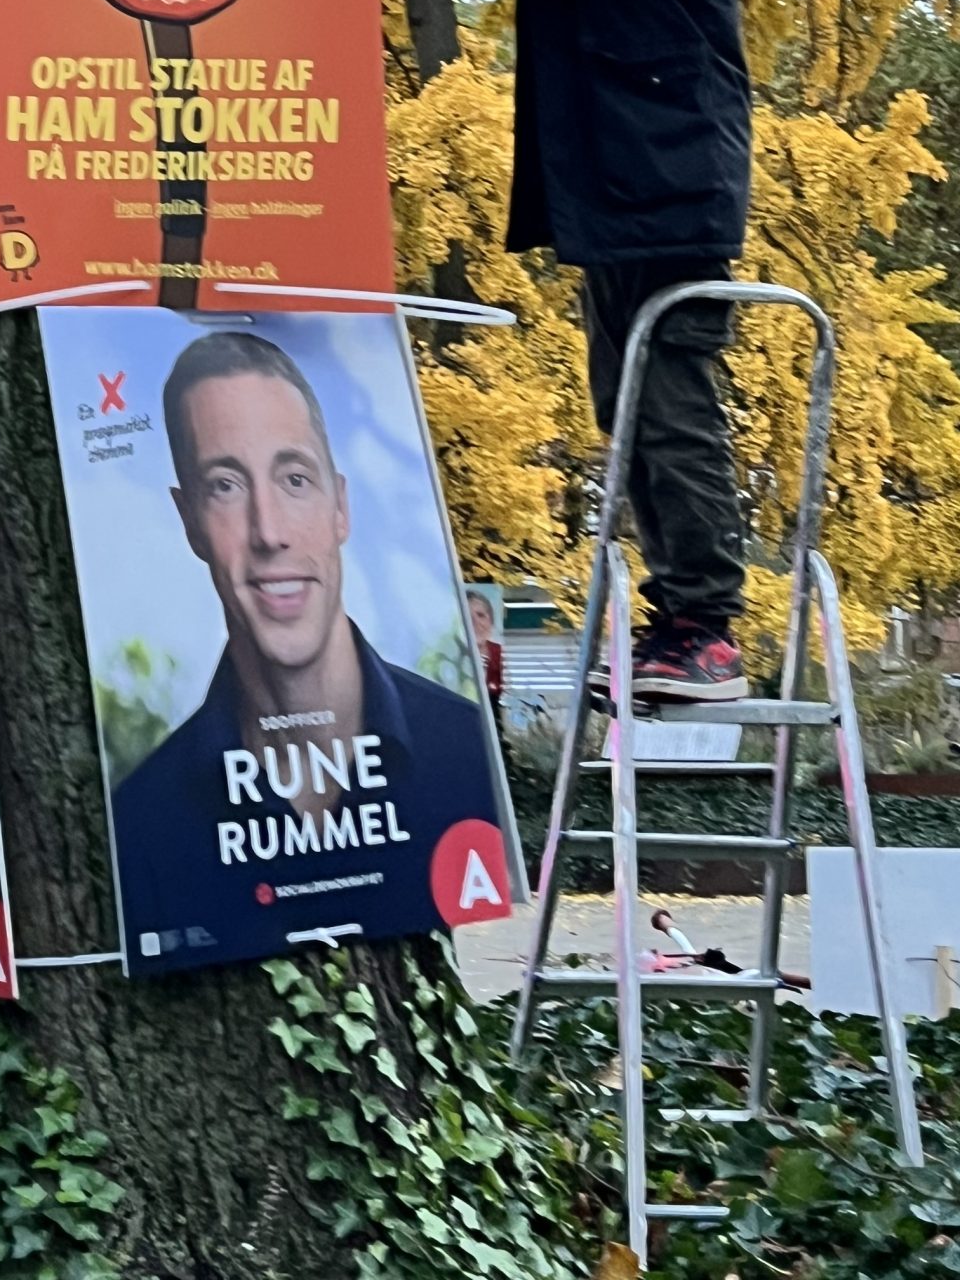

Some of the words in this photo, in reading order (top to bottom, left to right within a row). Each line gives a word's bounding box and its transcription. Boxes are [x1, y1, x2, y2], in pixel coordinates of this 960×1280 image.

[31, 57, 143, 89] OPSTIL
[150, 58, 266, 91] STATUE
[272, 60, 314, 91] AF
[6, 96, 116, 142] HAM
[129, 97, 339, 143] STOKKEN
[27, 143, 68, 180] PÅ
[75, 151, 314, 181] FREDERIKSBERG
[223, 734, 387, 805] RUNE
[218, 802, 410, 865] RUMMEL
[459, 849, 502, 909] A
